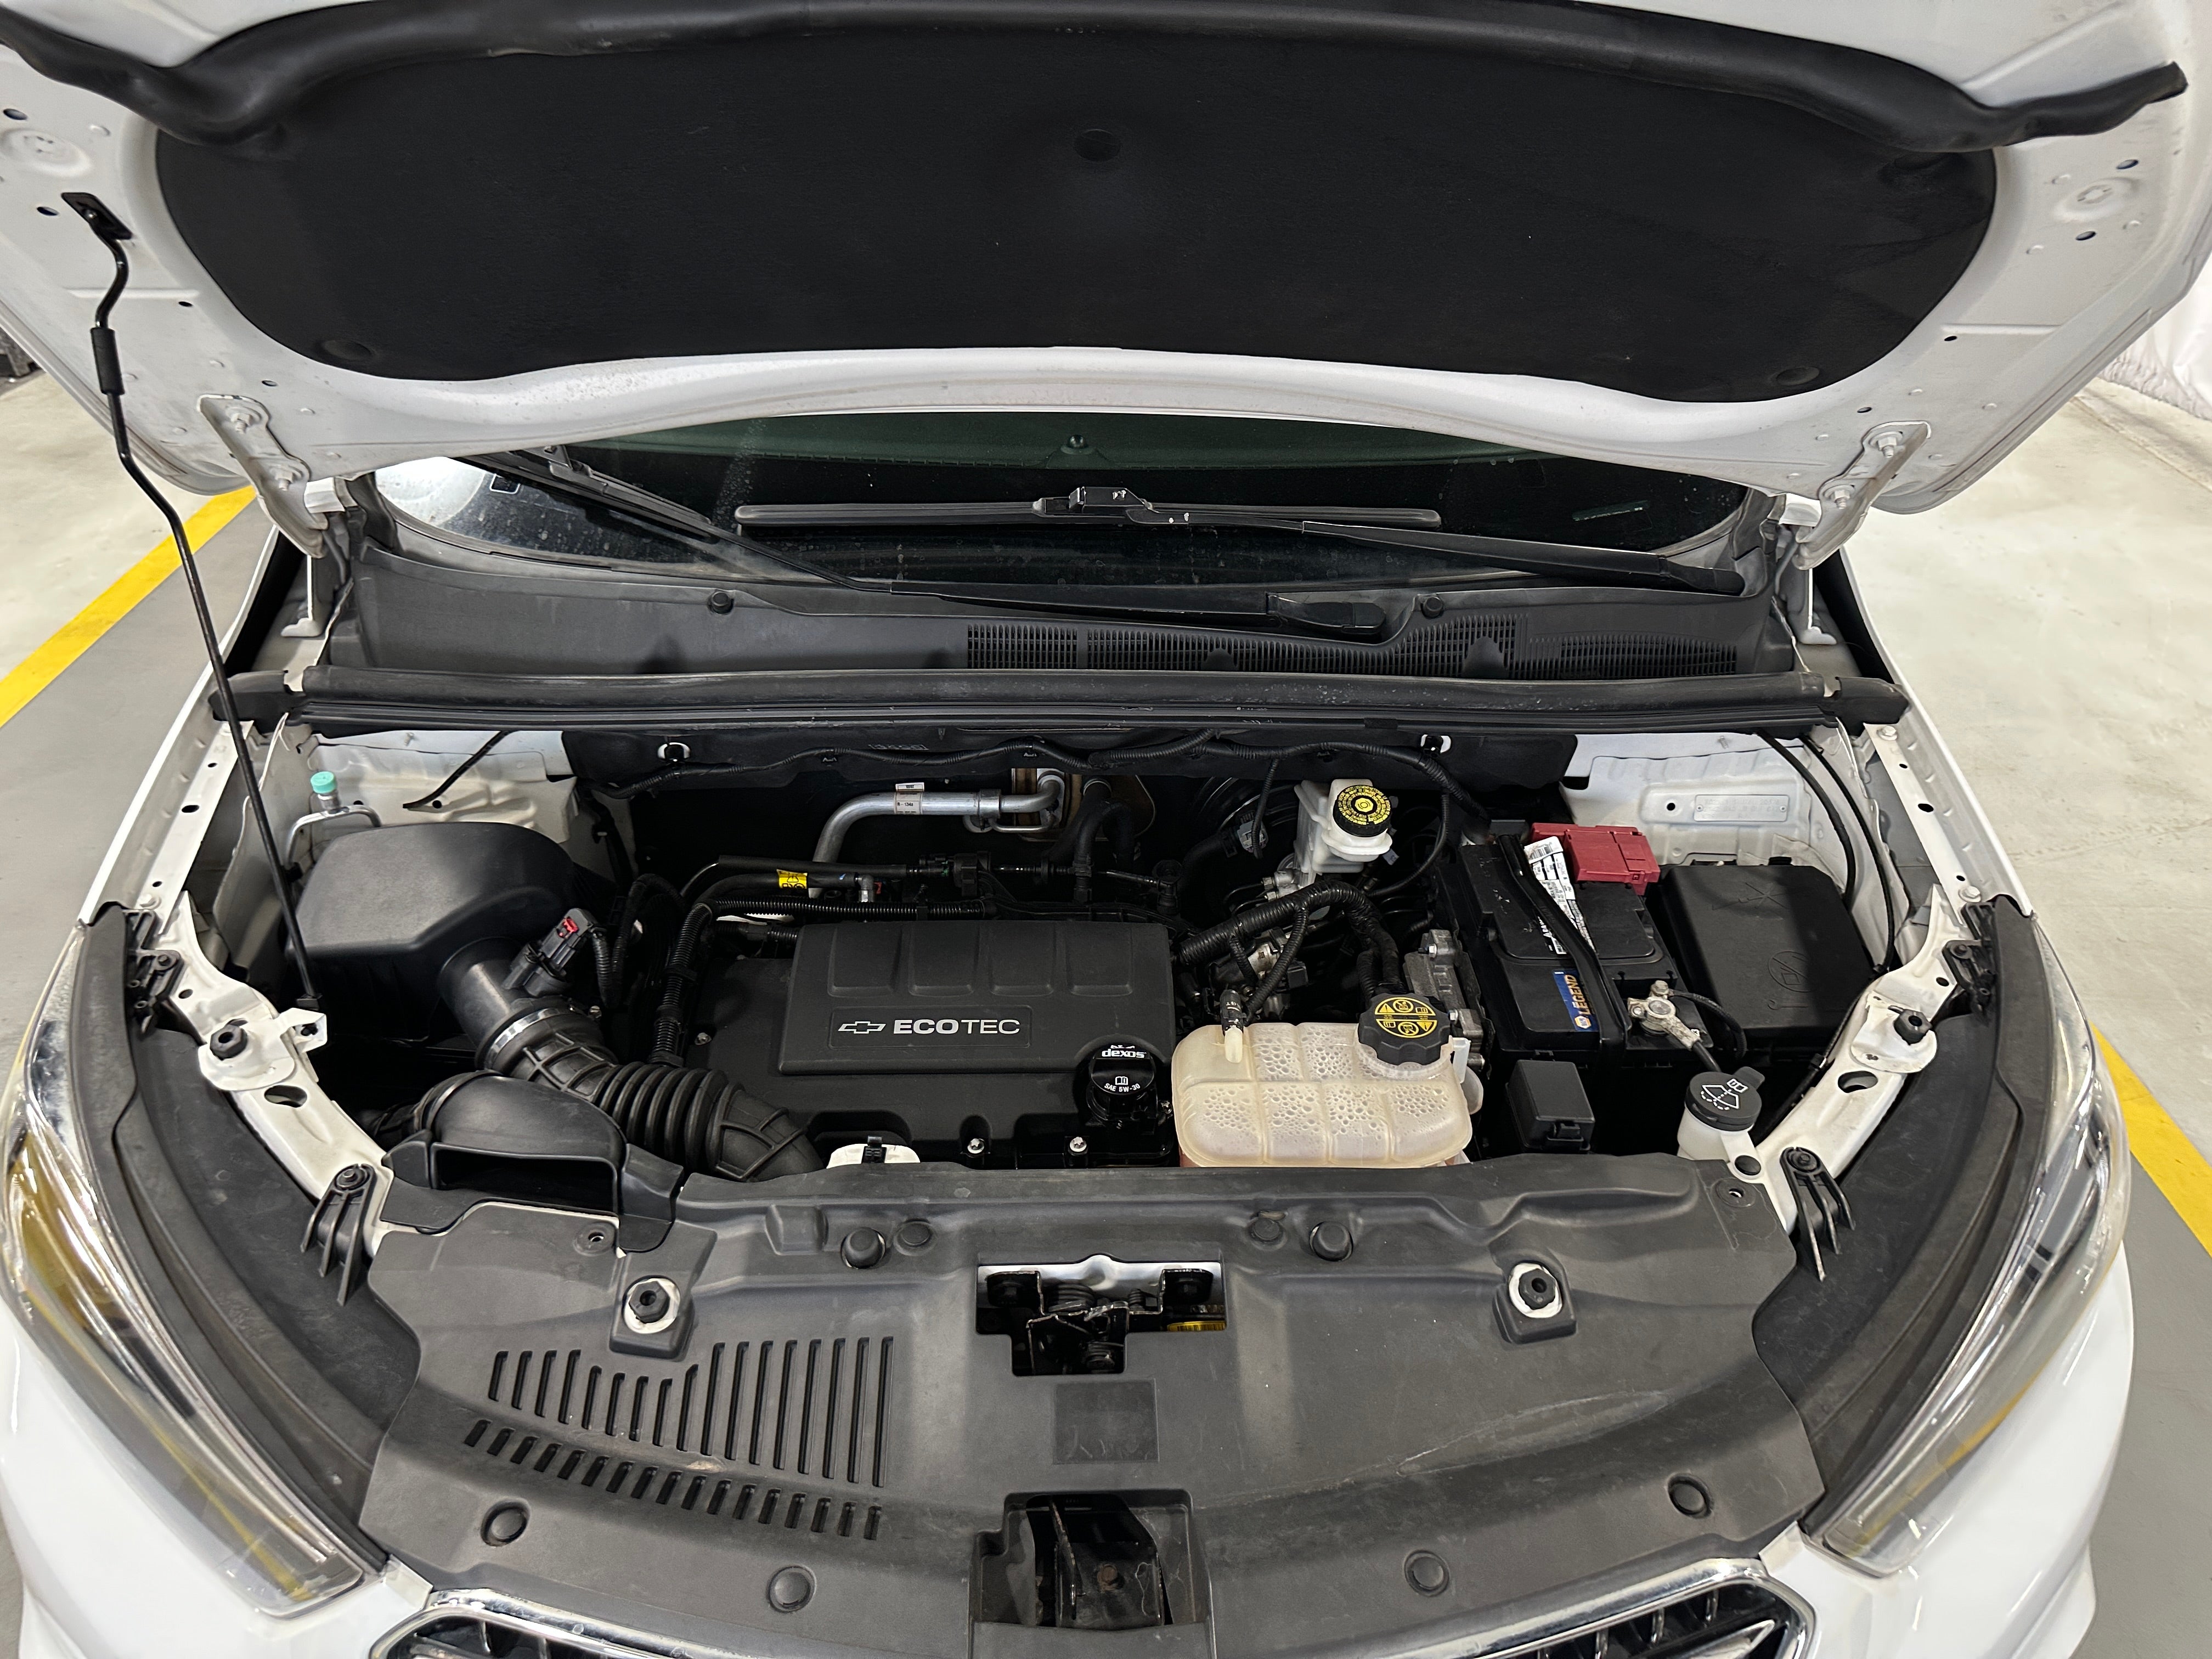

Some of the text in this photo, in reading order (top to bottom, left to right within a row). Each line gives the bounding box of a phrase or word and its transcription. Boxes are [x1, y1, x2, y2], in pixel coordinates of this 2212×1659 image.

[1564, 974, 1591, 1015] LEGEND
[893, 1019, 1020, 1035] ECOTEC
[1102, 1048, 1145, 1058] dexos
[1104, 1083, 1141, 1092] SAE 5W-30
